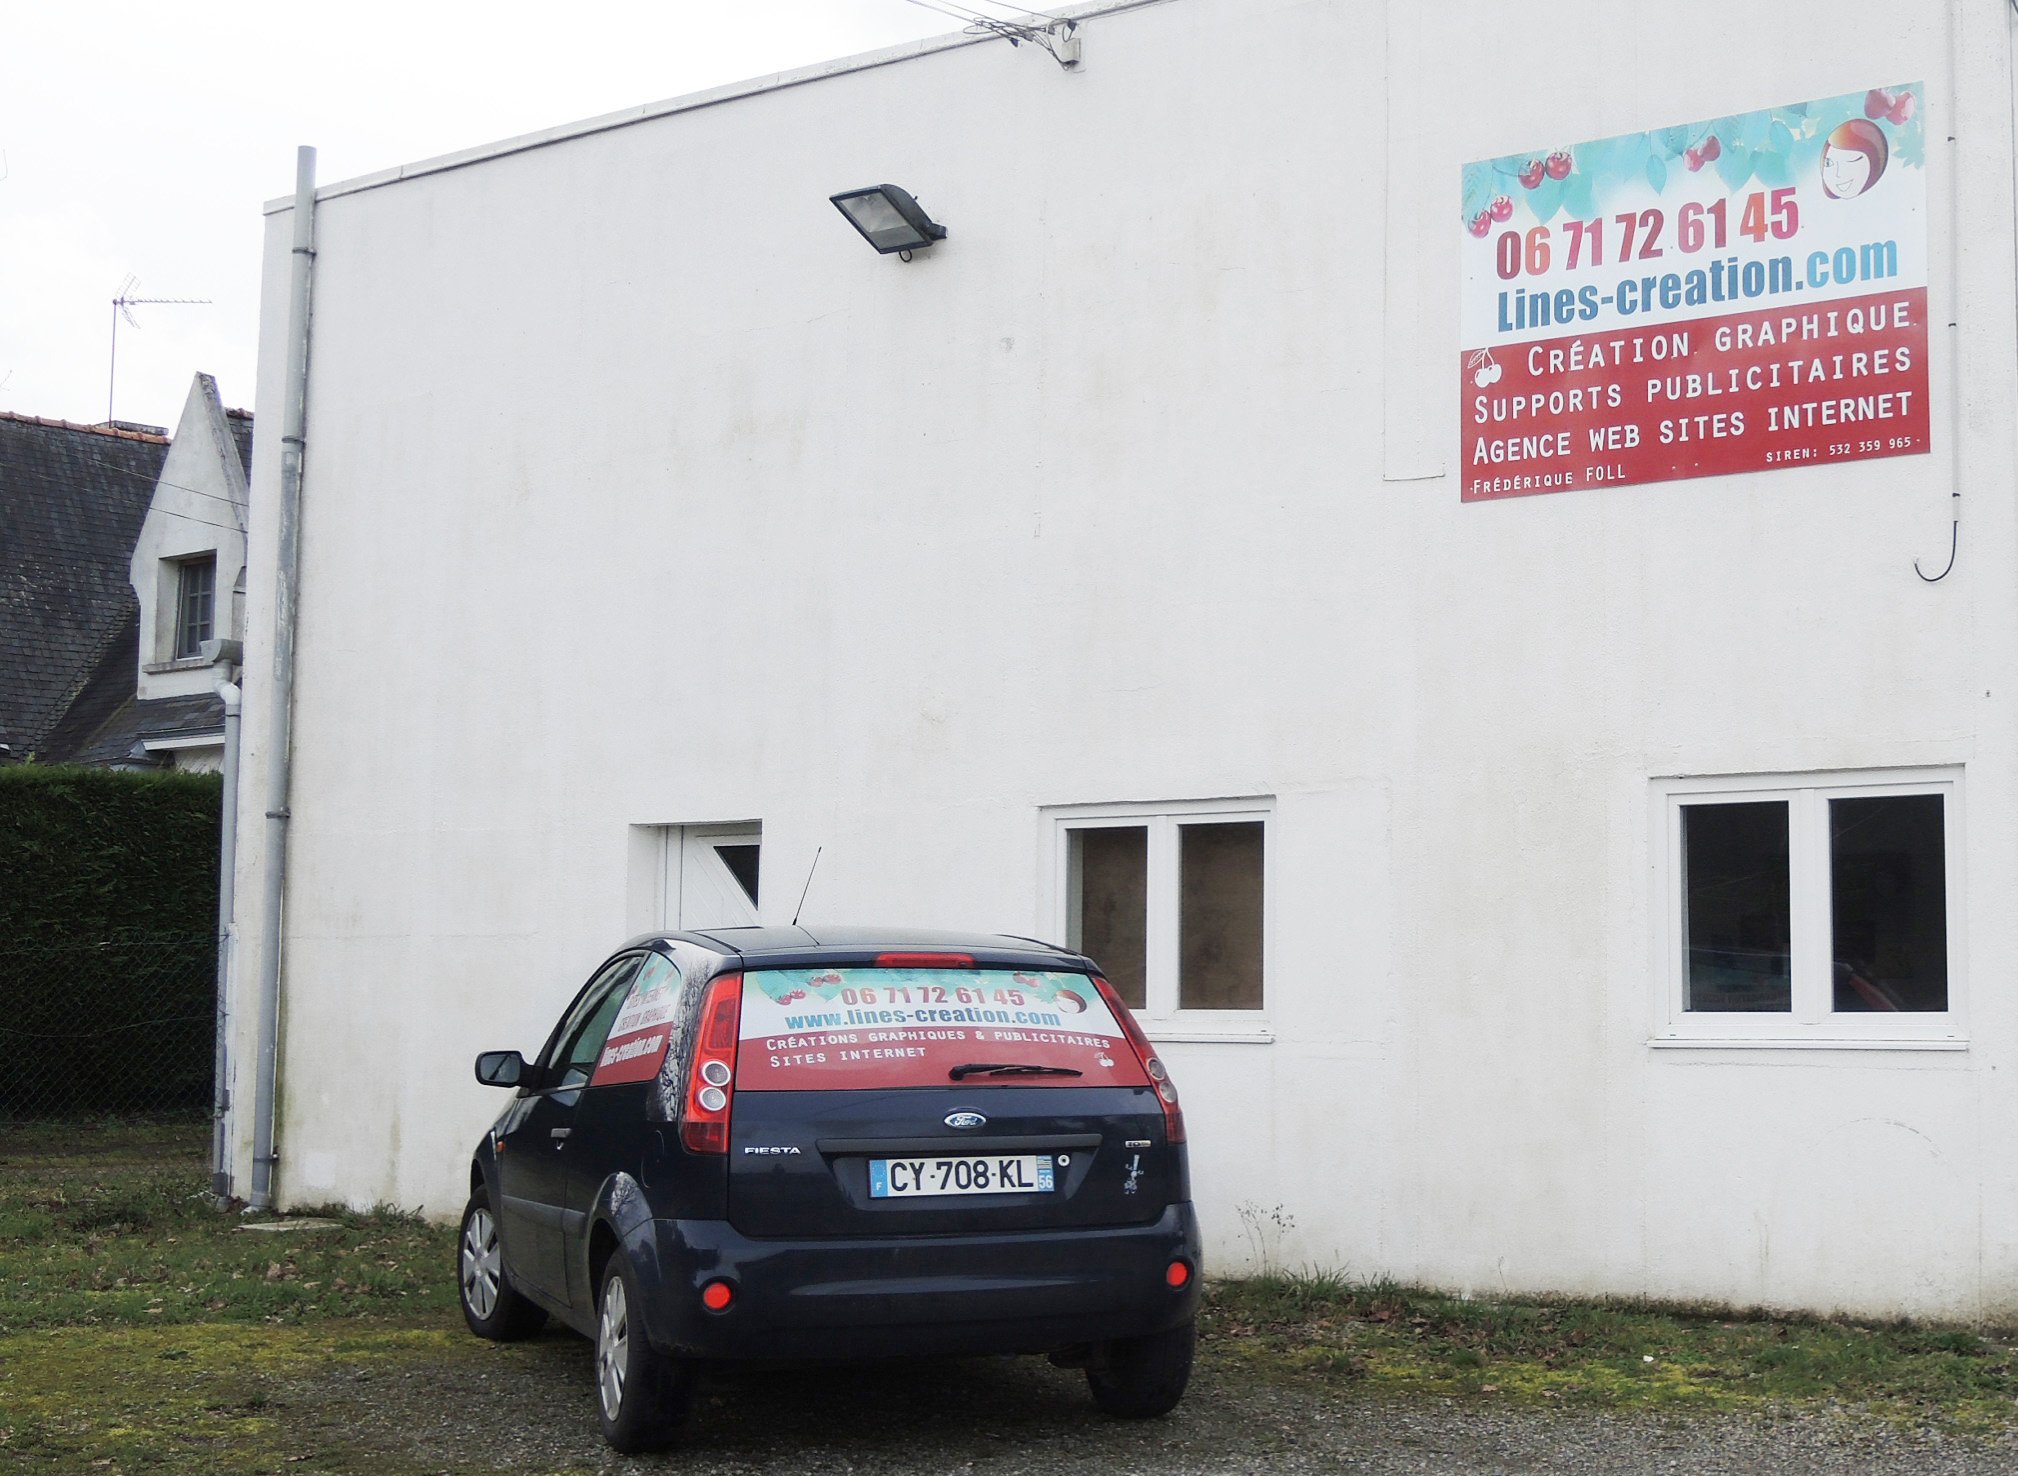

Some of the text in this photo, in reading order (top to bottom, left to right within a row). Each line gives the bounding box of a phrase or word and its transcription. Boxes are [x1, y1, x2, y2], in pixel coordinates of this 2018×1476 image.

[1496, 187, 1800, 280] 06 71 72 61 45
[1528, 301, 1910, 376] CRÉATION GRAPHIQUE
[1474, 346, 1912, 424] SUPPORTS PUBLICITAIRES
[1473, 391, 1913, 465] AGENCE WEB SITES INTERNET
[1766, 436, 1912, 463] SIREN: 532 359 965
[1586, 464, 1626, 482] FOLL
[841, 986, 1025, 1006] 06 71 72 61 45
[785, 1008, 1061, 1030] www.lines-creation.com
[868, 1030, 966, 1043] GRAPHIQUES
[975, 1031, 985, 1040] &
[995, 1031, 1111, 1049] PUBLICITAIRES
[770, 1047, 926, 1068] SITES INTERNET
[744, 1147, 801, 1155] FIESTA
[875, 1181, 883, 1191] F
[1038, 1174, 1053, 1189] 56
